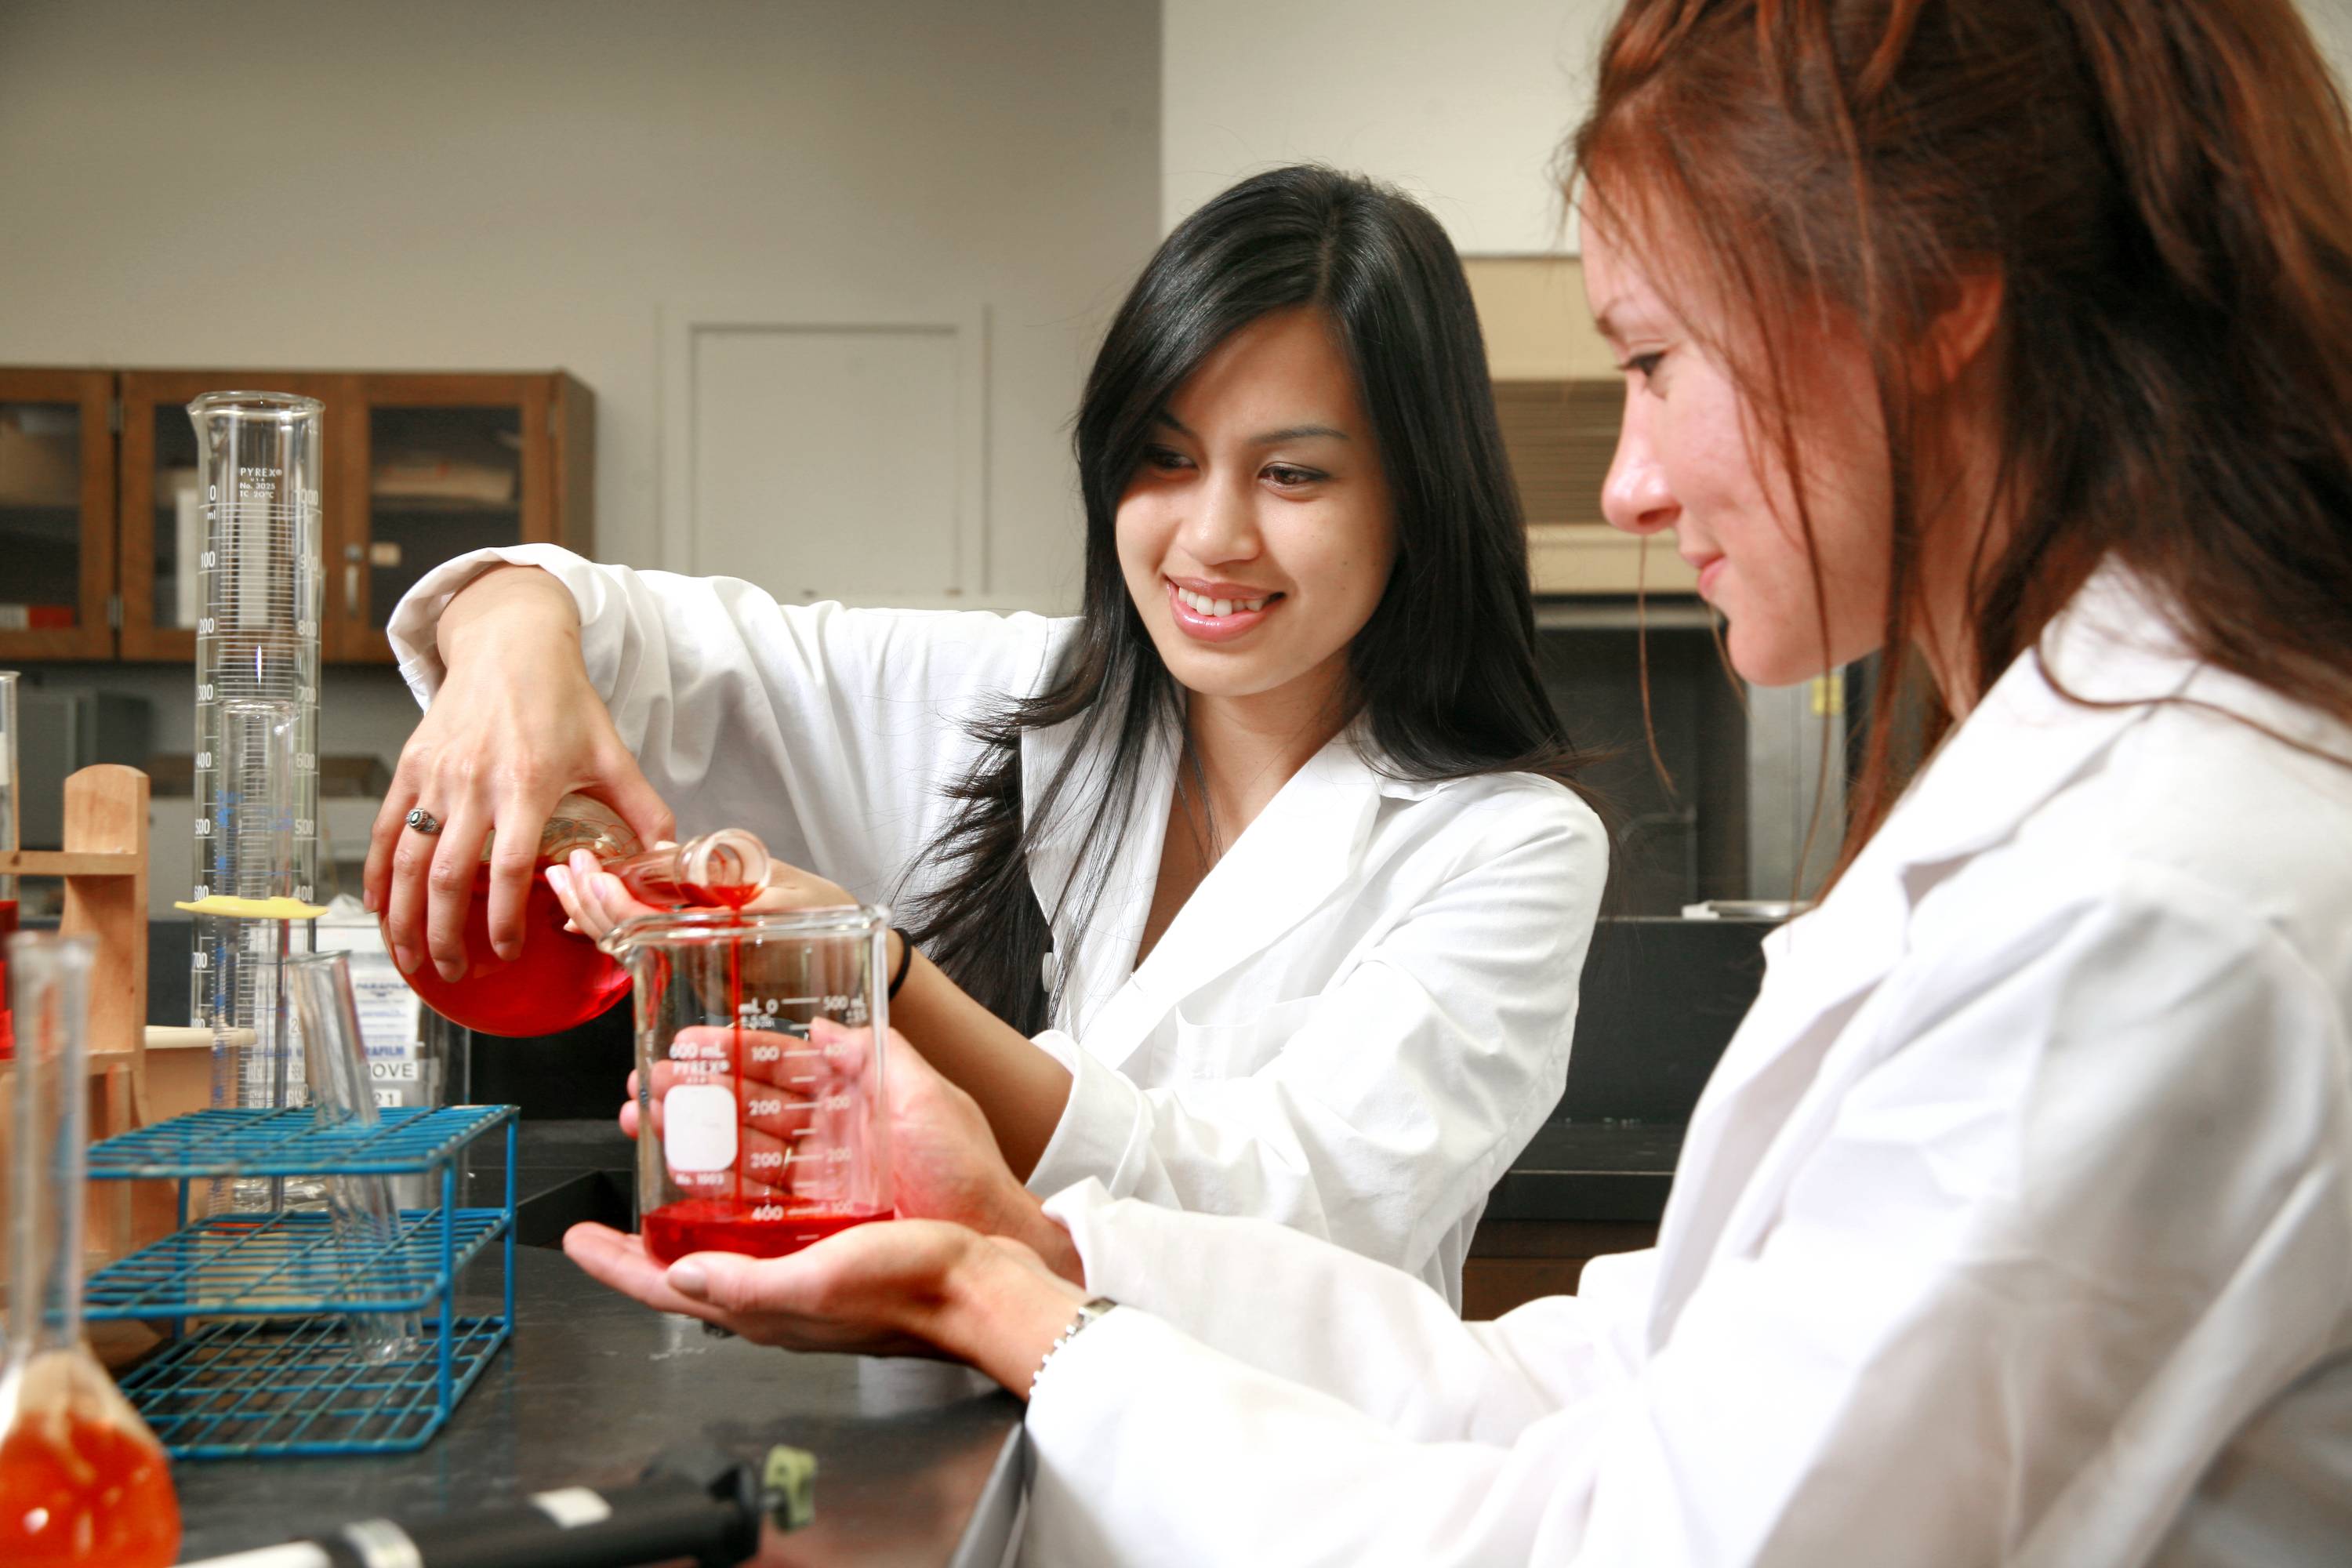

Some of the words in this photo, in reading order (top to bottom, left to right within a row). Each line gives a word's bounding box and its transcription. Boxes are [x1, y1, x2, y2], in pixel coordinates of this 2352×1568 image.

[209, 485, 216, 501] 0
[201, 551, 216, 568] 100
[198, 618, 215, 634] 200
[297, 620, 317, 637] 800
[198, 684, 213, 701] 300
[298, 686, 316, 702] 700
[196, 752, 212, 768] 400
[296, 752, 315, 768] 600
[195, 818, 210, 835] 500
[295, 818, 314, 834] 500
[293, 885, 314, 901] 400
[766, 999, 779, 1014] 0
[823, 996, 848, 1011] 500
[752, 1046, 780, 1062] 100
[749, 1099, 781, 1116] 200
